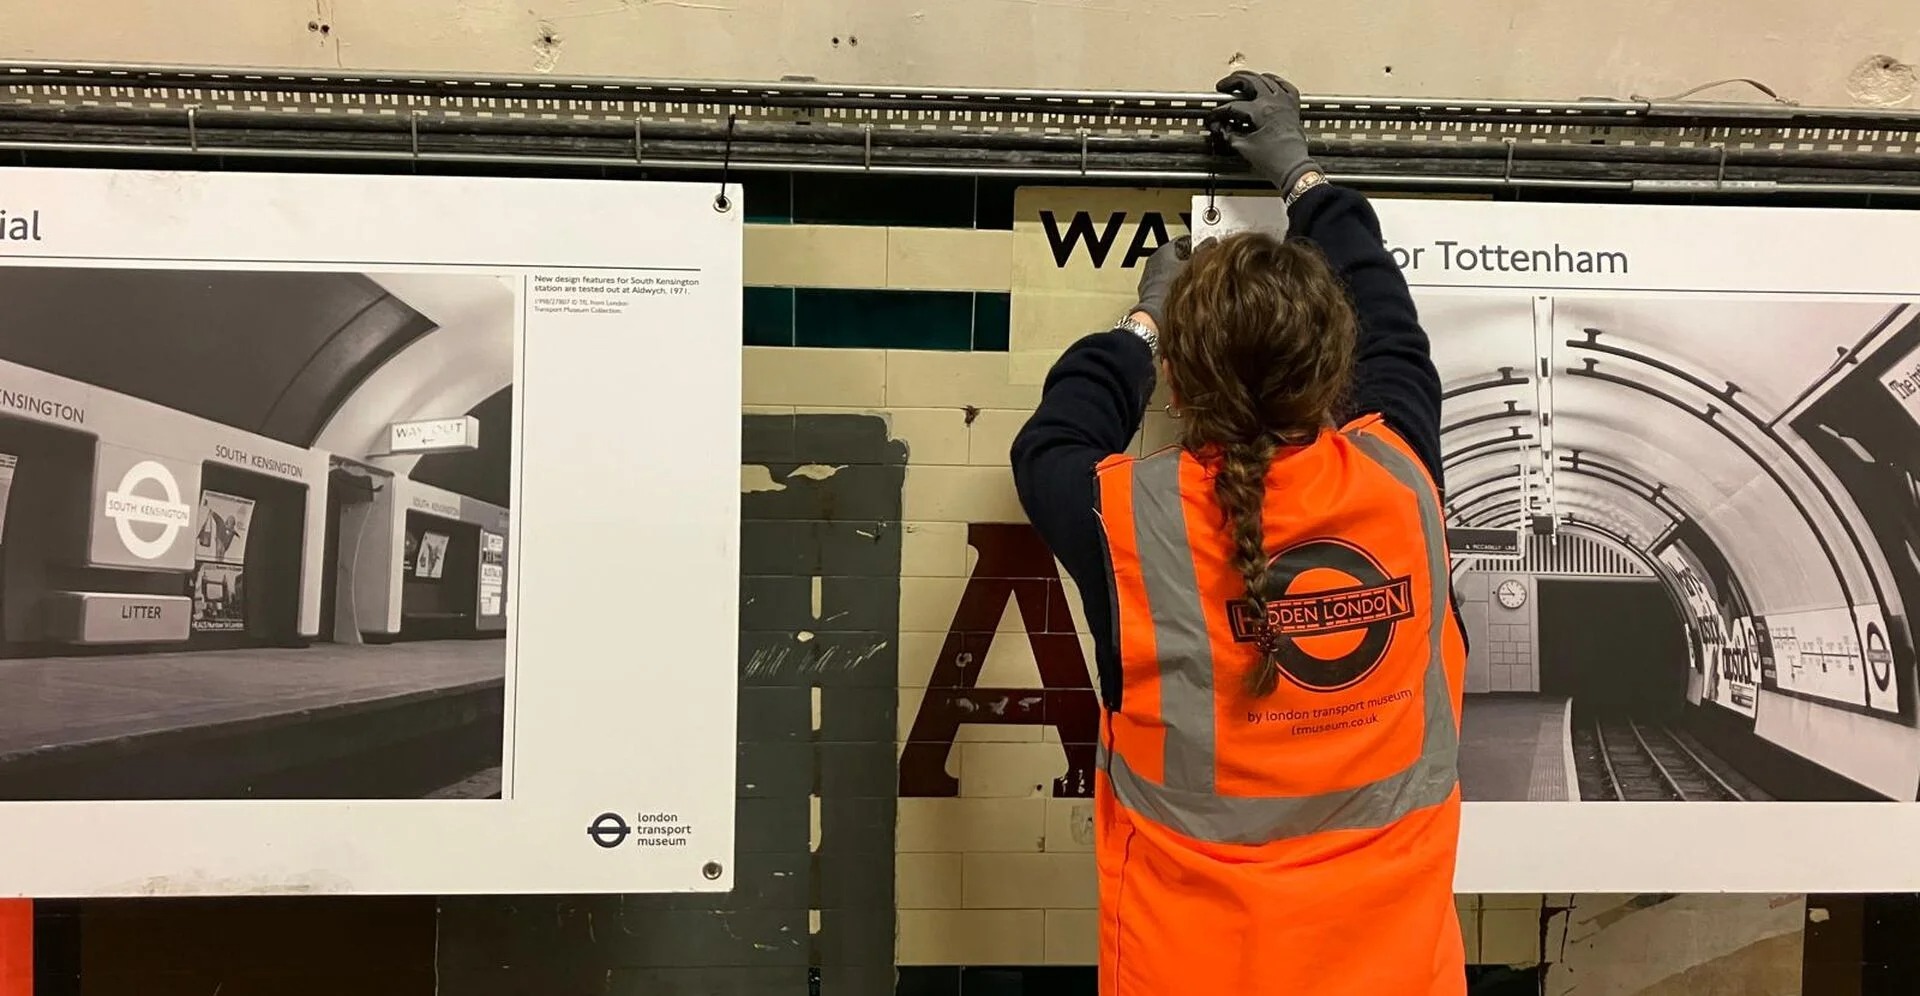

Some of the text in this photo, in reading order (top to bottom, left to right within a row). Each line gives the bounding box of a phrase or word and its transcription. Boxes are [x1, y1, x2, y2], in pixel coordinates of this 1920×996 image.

[0, 209, 41, 240] ial
[1382, 239, 1628, 273] or Tottenham
[534, 275, 700, 287] New design features for South Kensington
[534, 284, 562, 292] station
[579, 285, 604, 293] tested
[0, 388, 85, 424] NSINGTON
[215, 444, 303, 477] SOUTH KENSINGTON
[108, 499, 188, 520] SOUTH KENSINGTON
[122, 605, 161, 619] LITTER
[1237, 583, 1407, 635] HDDEN LONDON
[1247, 689, 1413, 725] by london transport museum
[637, 812, 678, 822] london
[637, 825, 692, 836] transport
[637, 837, 686, 846] museum
